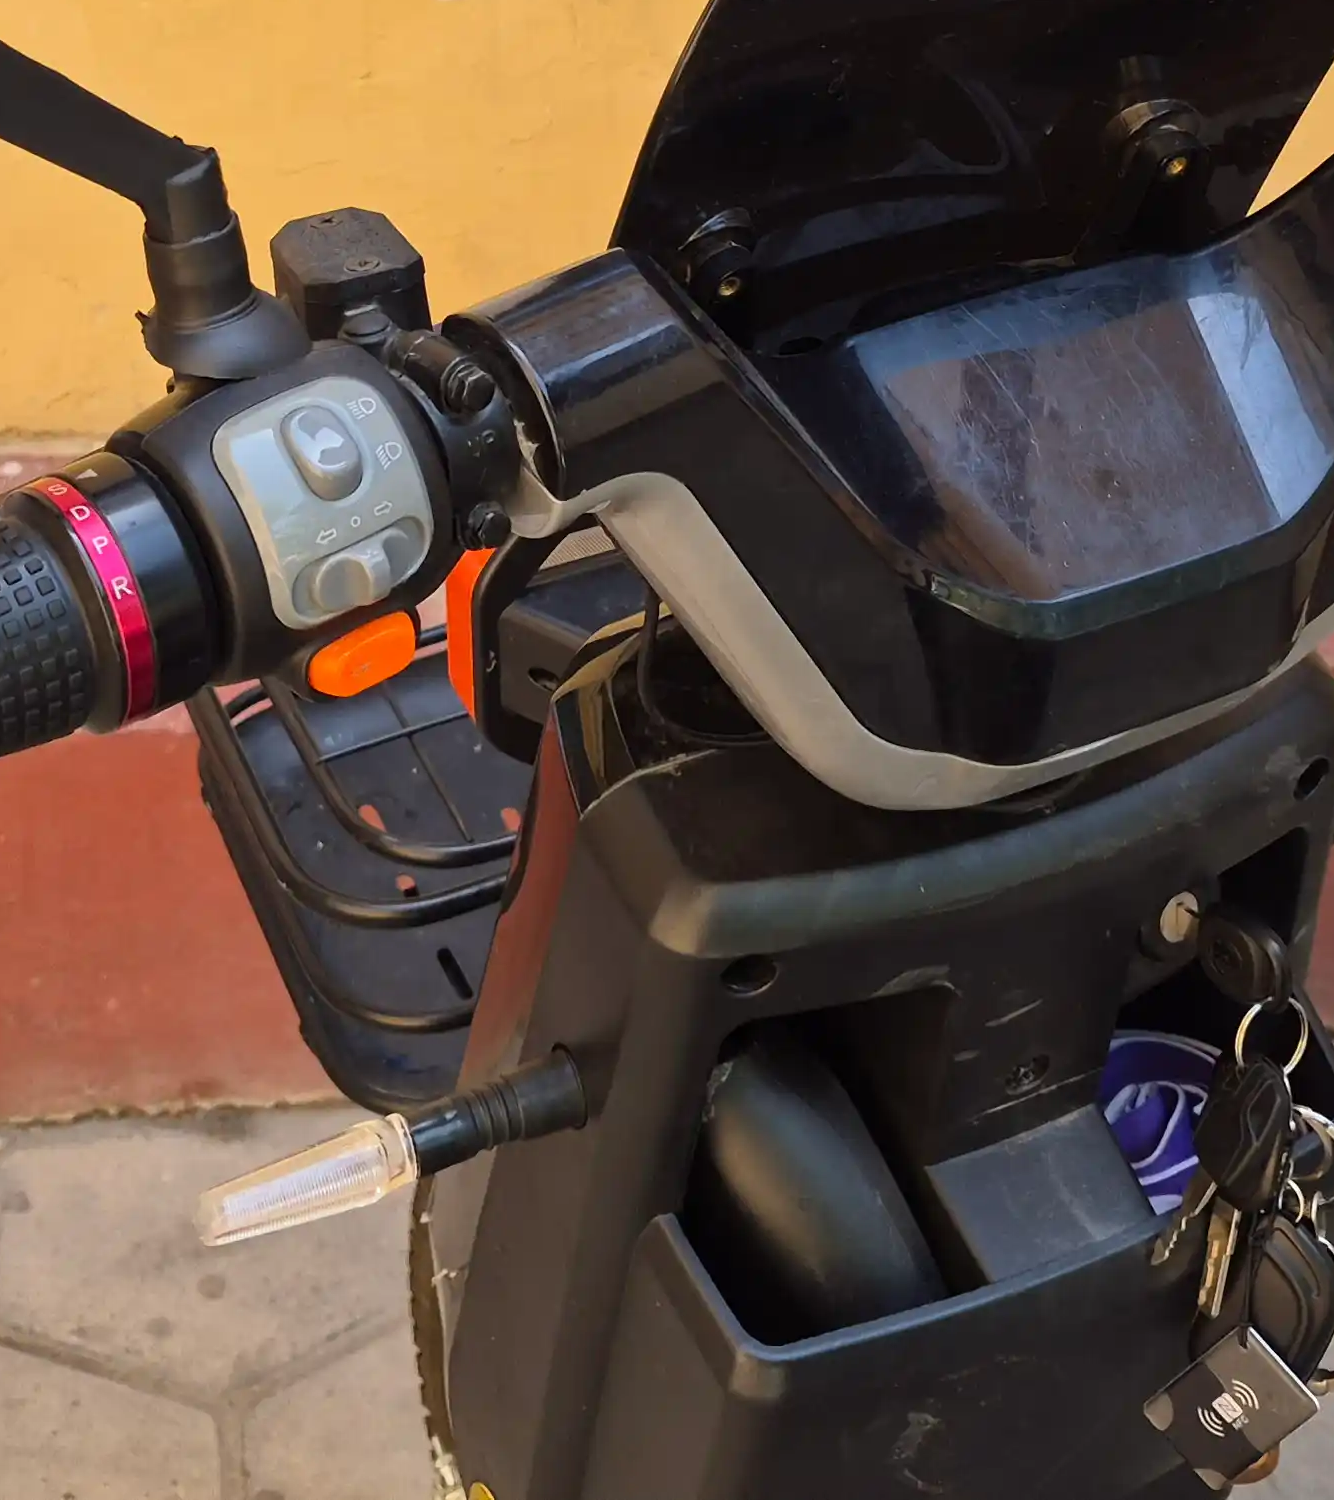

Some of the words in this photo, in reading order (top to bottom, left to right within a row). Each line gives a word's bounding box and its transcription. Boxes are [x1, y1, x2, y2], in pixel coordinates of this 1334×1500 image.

[47, 483, 67, 495] S
[69, 505, 91, 521] D
[91, 536, 108, 554] P
[110, 576, 135, 600] R
